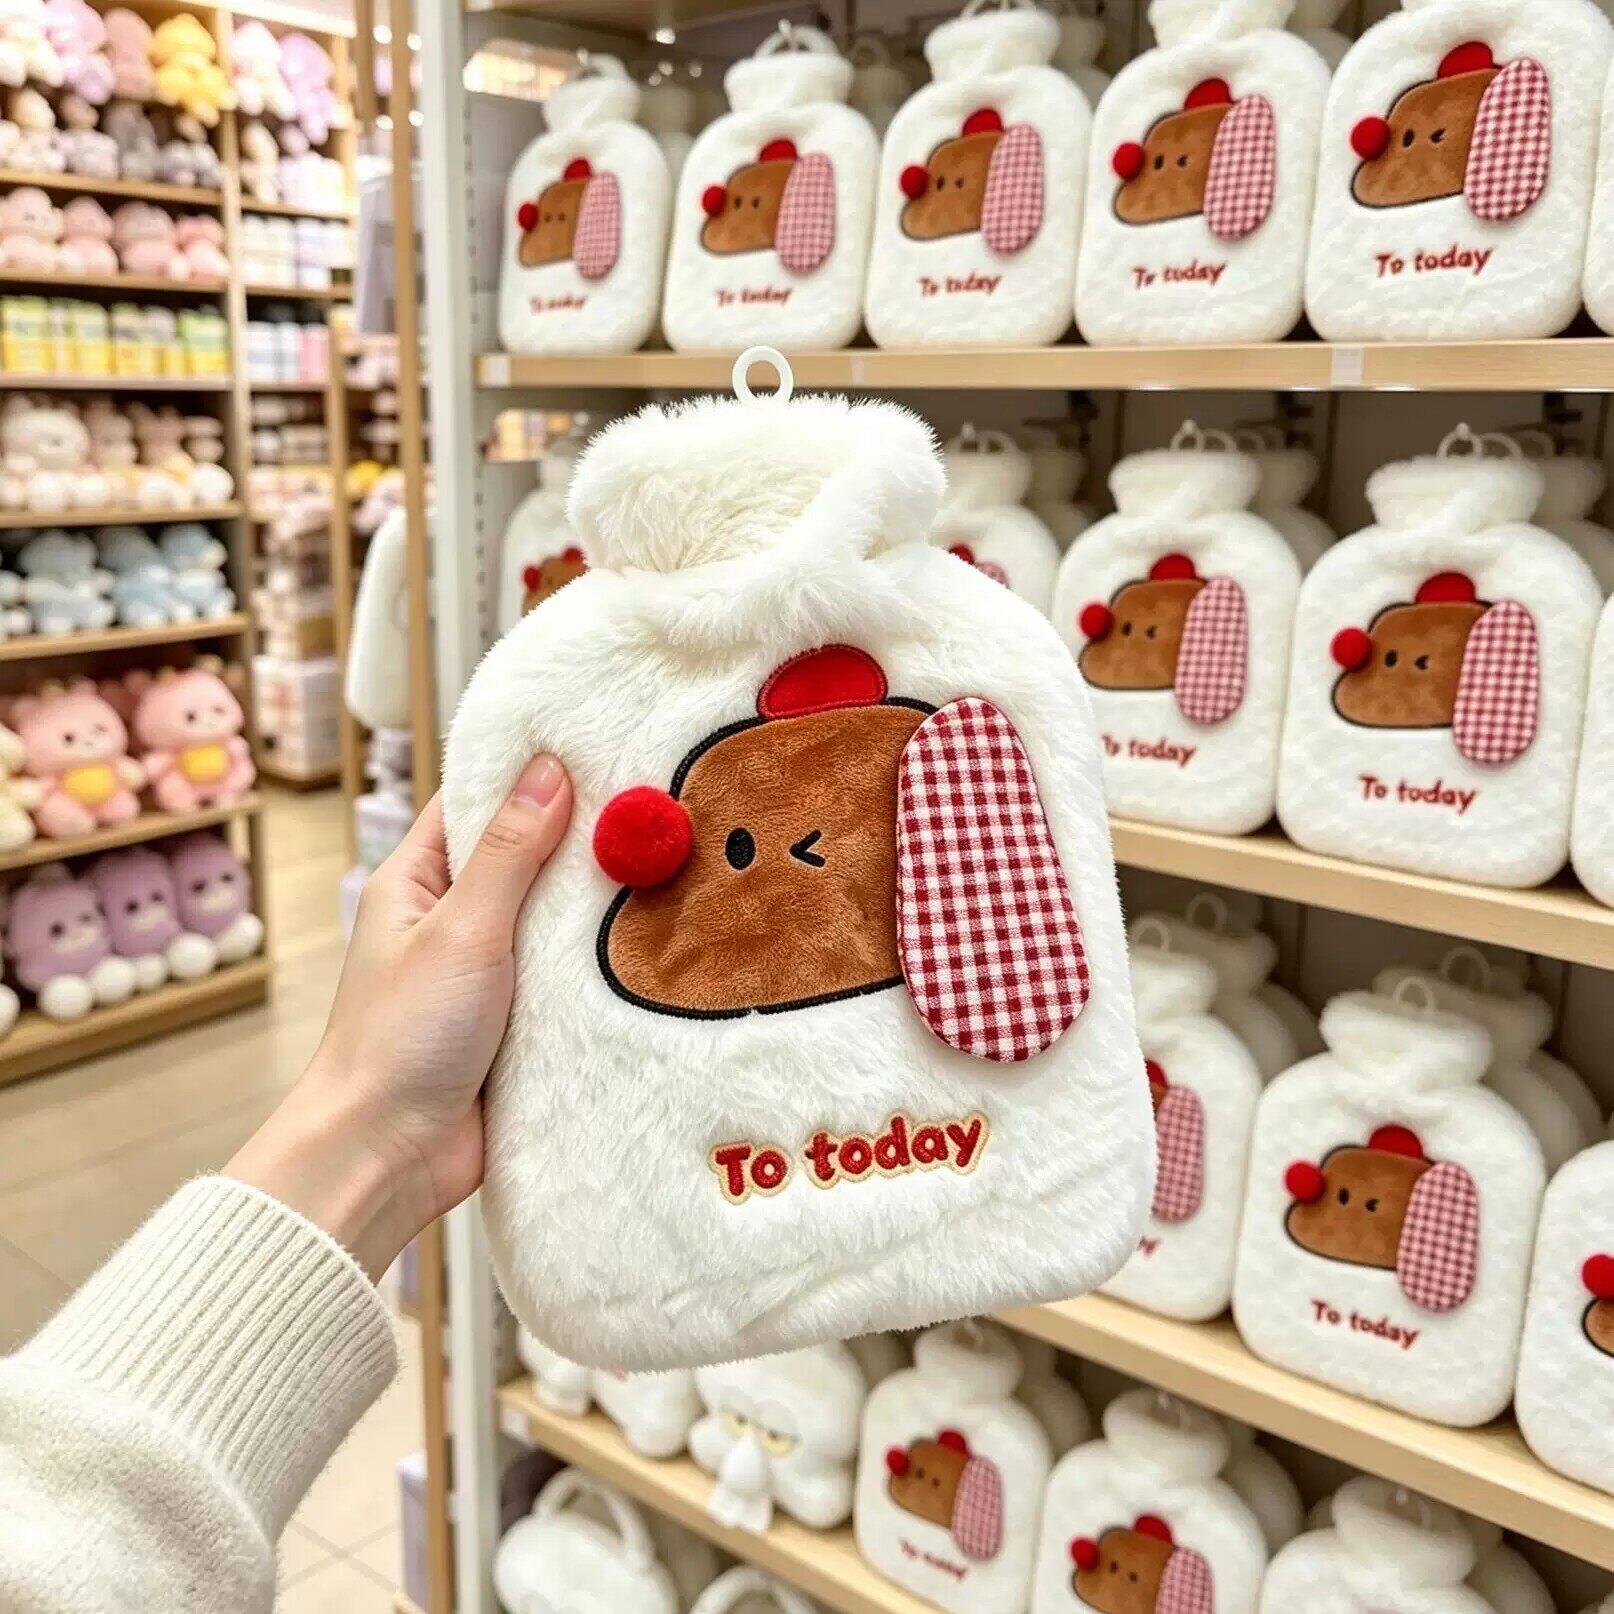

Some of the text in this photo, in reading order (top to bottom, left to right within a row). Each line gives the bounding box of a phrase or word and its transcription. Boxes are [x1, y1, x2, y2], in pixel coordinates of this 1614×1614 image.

[1162, 258, 1227, 286] today
[1375, 245, 1493, 277] To today
[1128, 737, 1196, 768] today
[1359, 775, 1477, 815] To today
[714, 1116, 983, 1197] To today
[1311, 1299, 1419, 1350] To today
